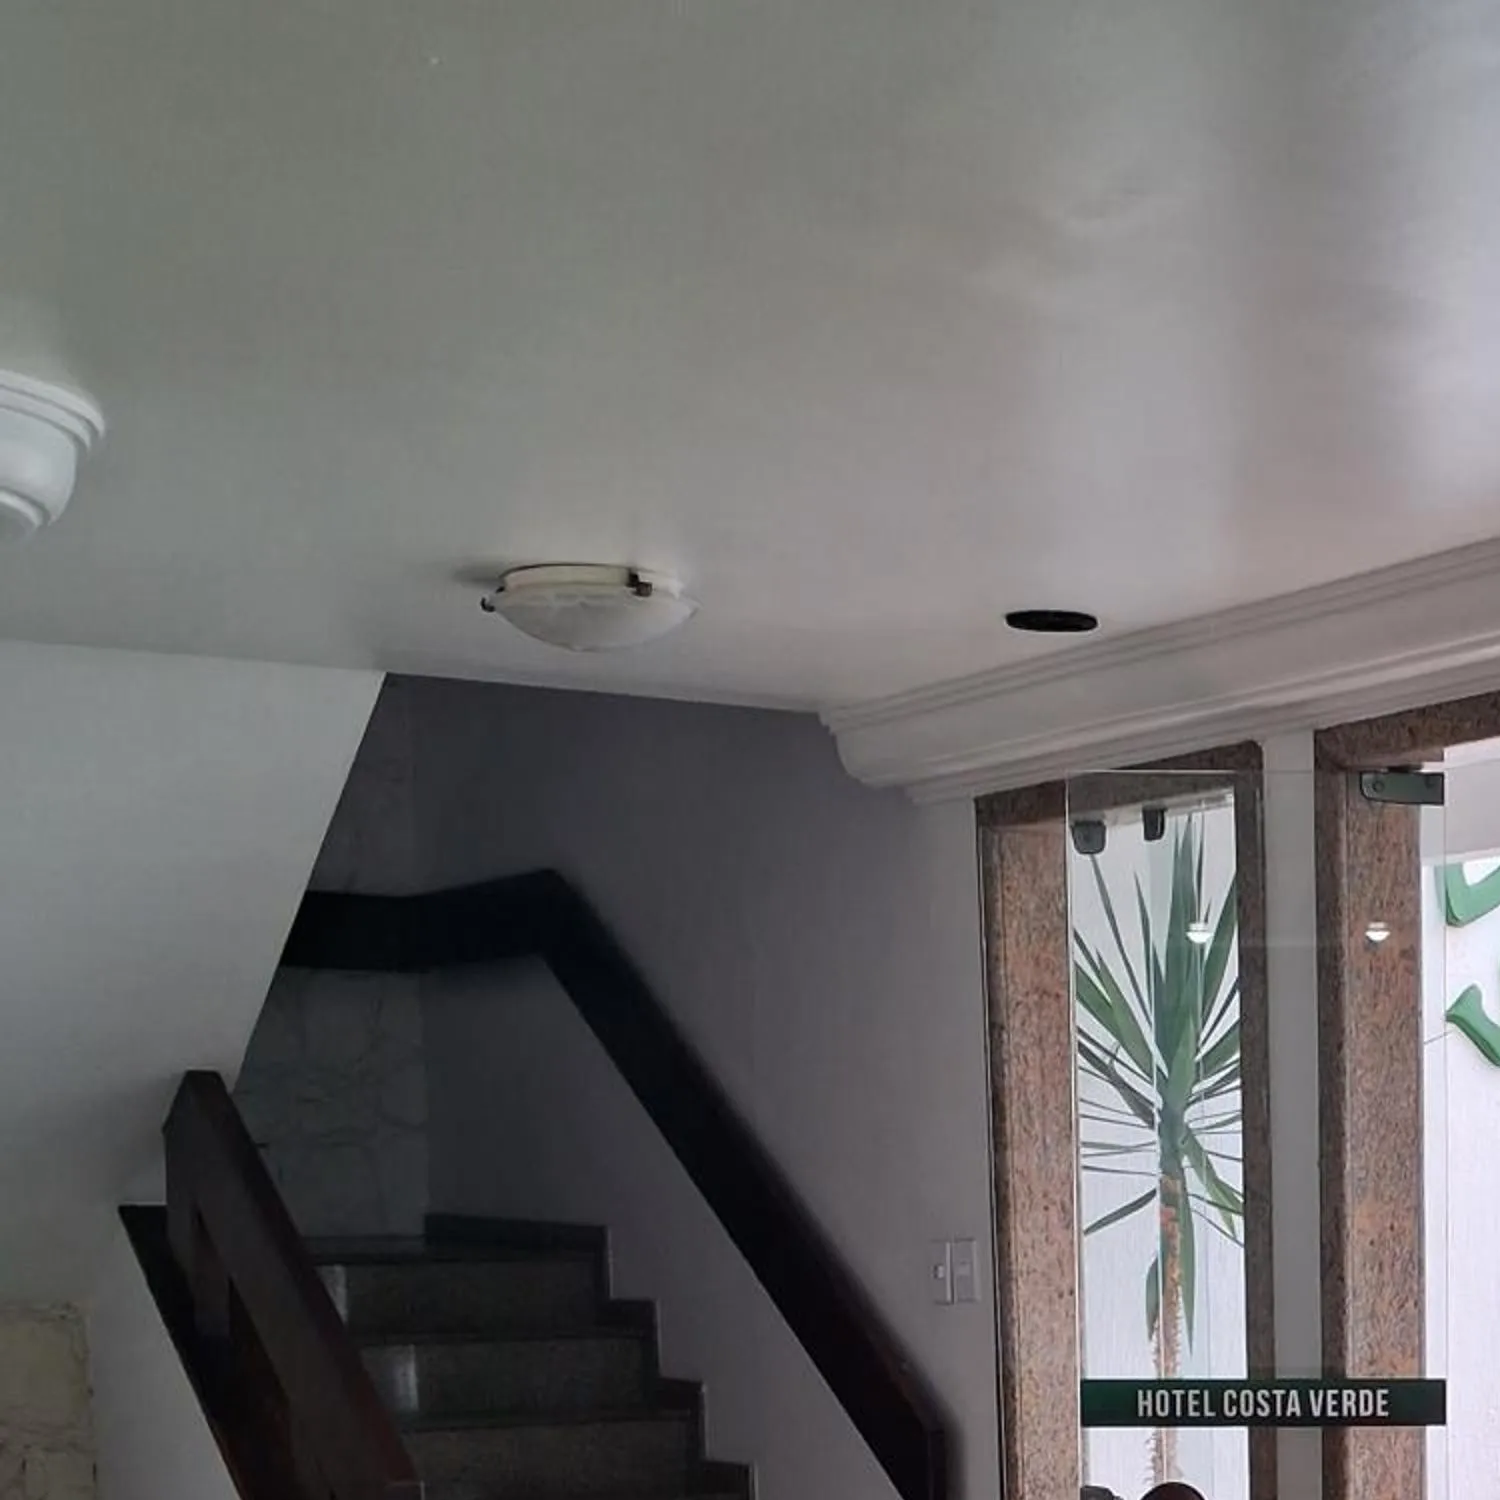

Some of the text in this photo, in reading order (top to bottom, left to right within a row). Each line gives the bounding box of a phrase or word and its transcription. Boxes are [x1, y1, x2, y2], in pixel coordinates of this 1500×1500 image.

[1137, 1389, 1390, 1417] HOTEL COSTA VERDE
